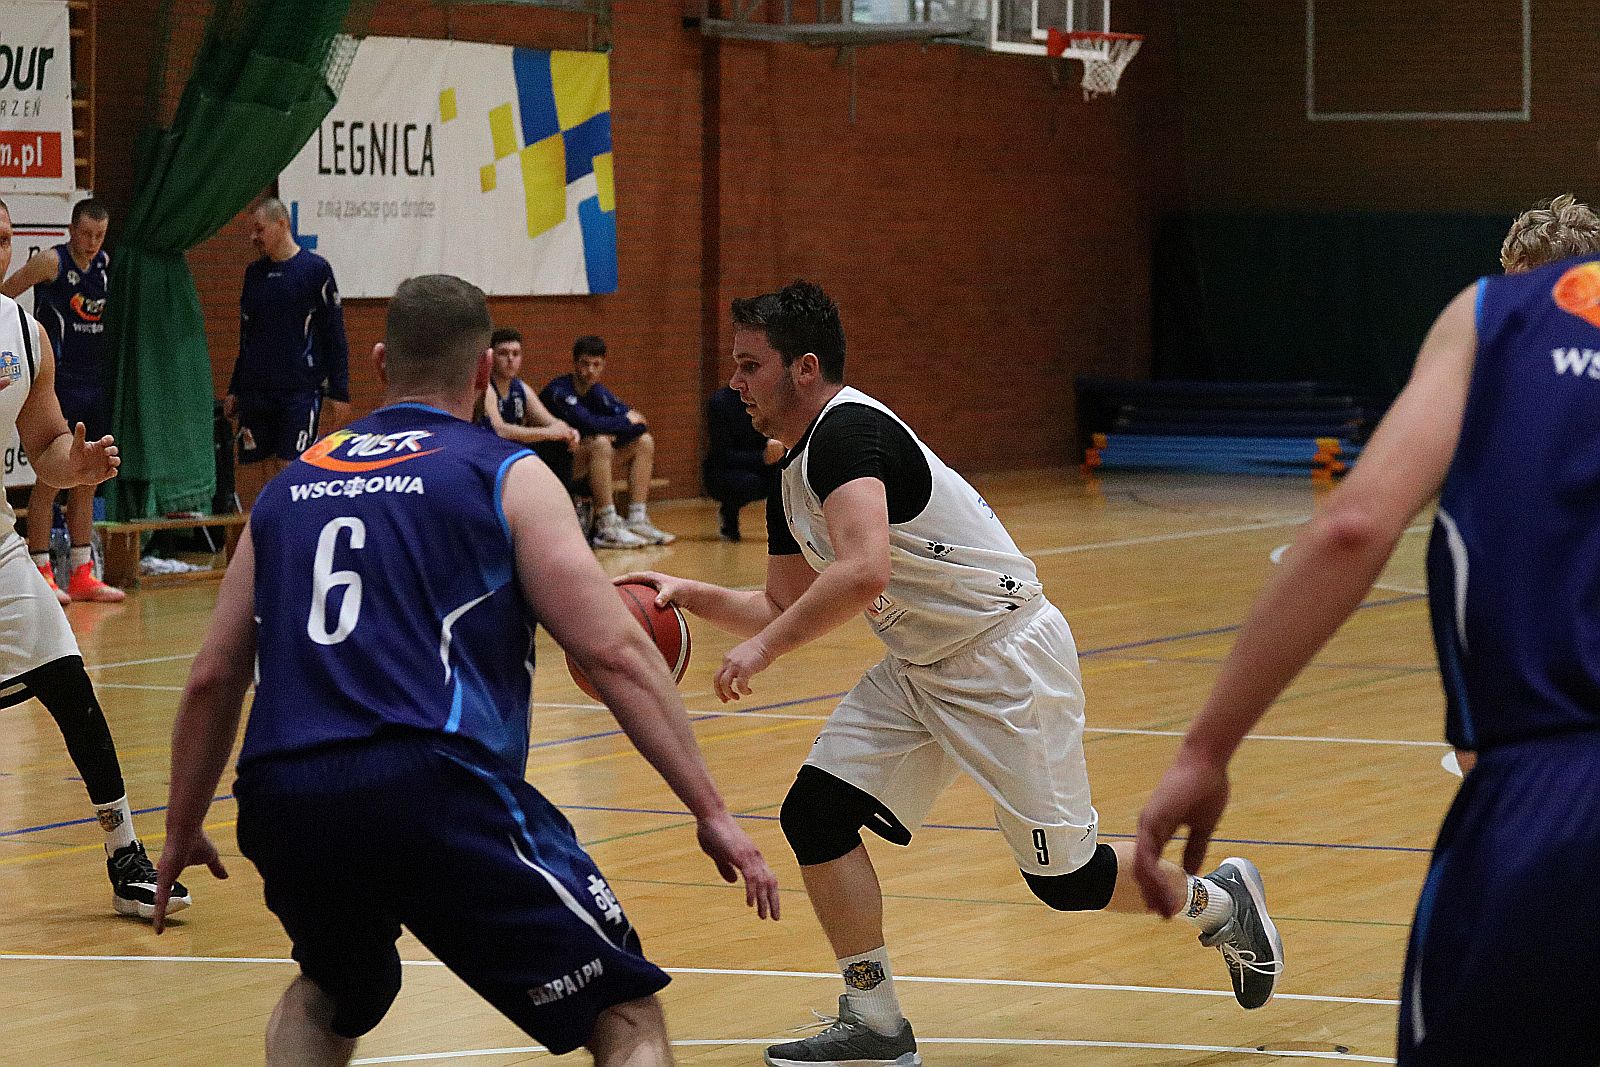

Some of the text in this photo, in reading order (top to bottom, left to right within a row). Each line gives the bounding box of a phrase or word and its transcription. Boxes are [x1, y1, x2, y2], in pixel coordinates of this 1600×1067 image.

[319, 121, 434, 177] LEGNICA
[307, 516, 366, 645] 6
[1031, 828, 1050, 866] 9
